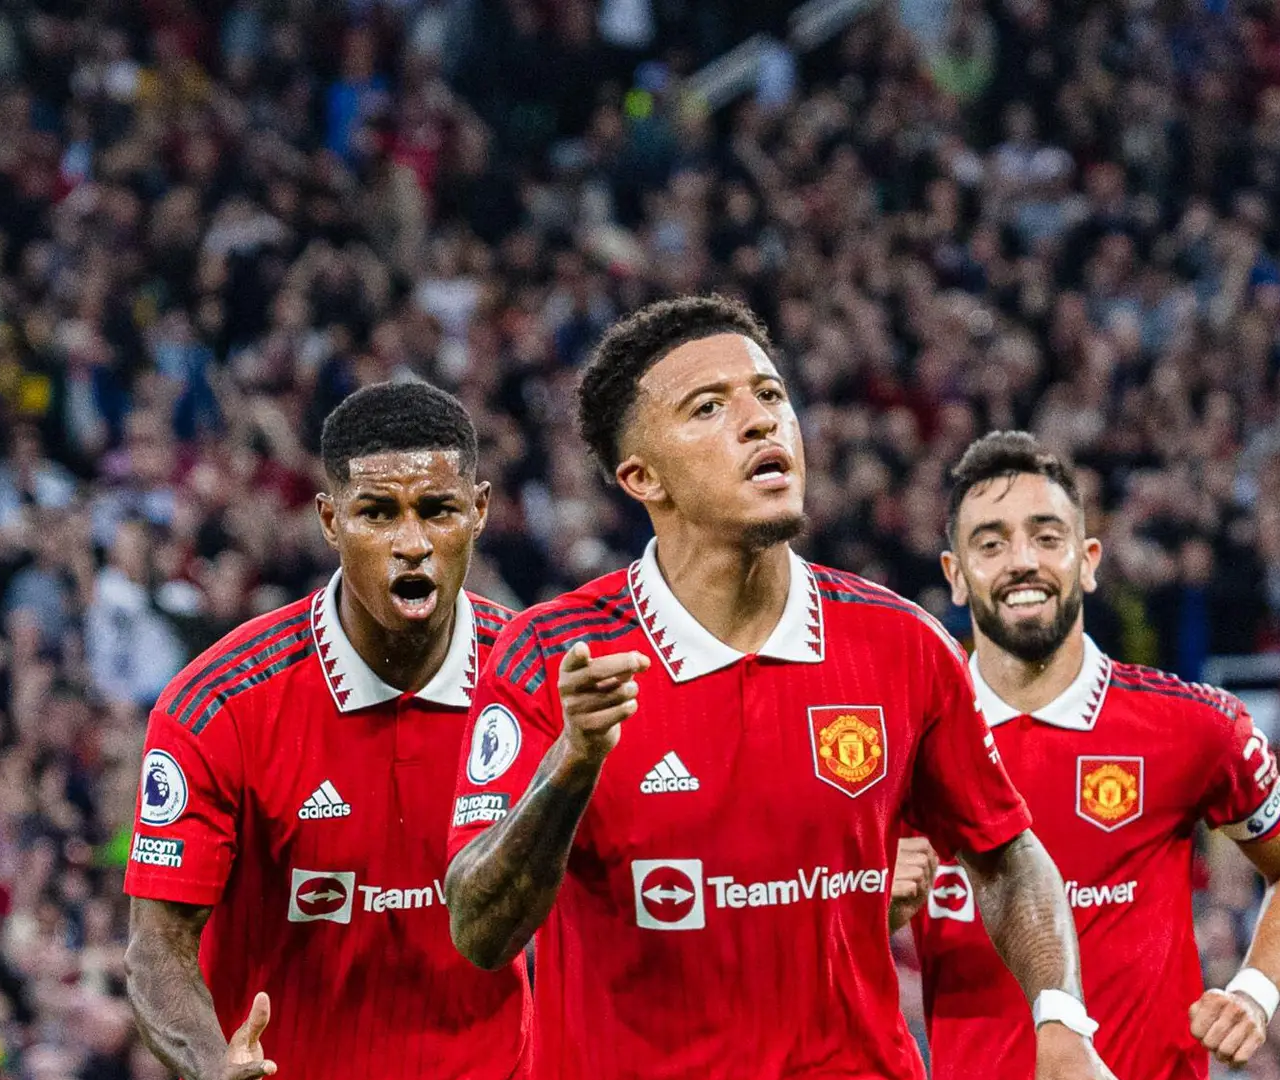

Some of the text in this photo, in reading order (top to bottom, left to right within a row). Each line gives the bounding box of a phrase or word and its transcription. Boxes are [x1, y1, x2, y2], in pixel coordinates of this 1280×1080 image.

[640, 776, 700, 794] adidas
[298, 803, 352, 820] adidas
[707, 866, 888, 909] TeamViewer
